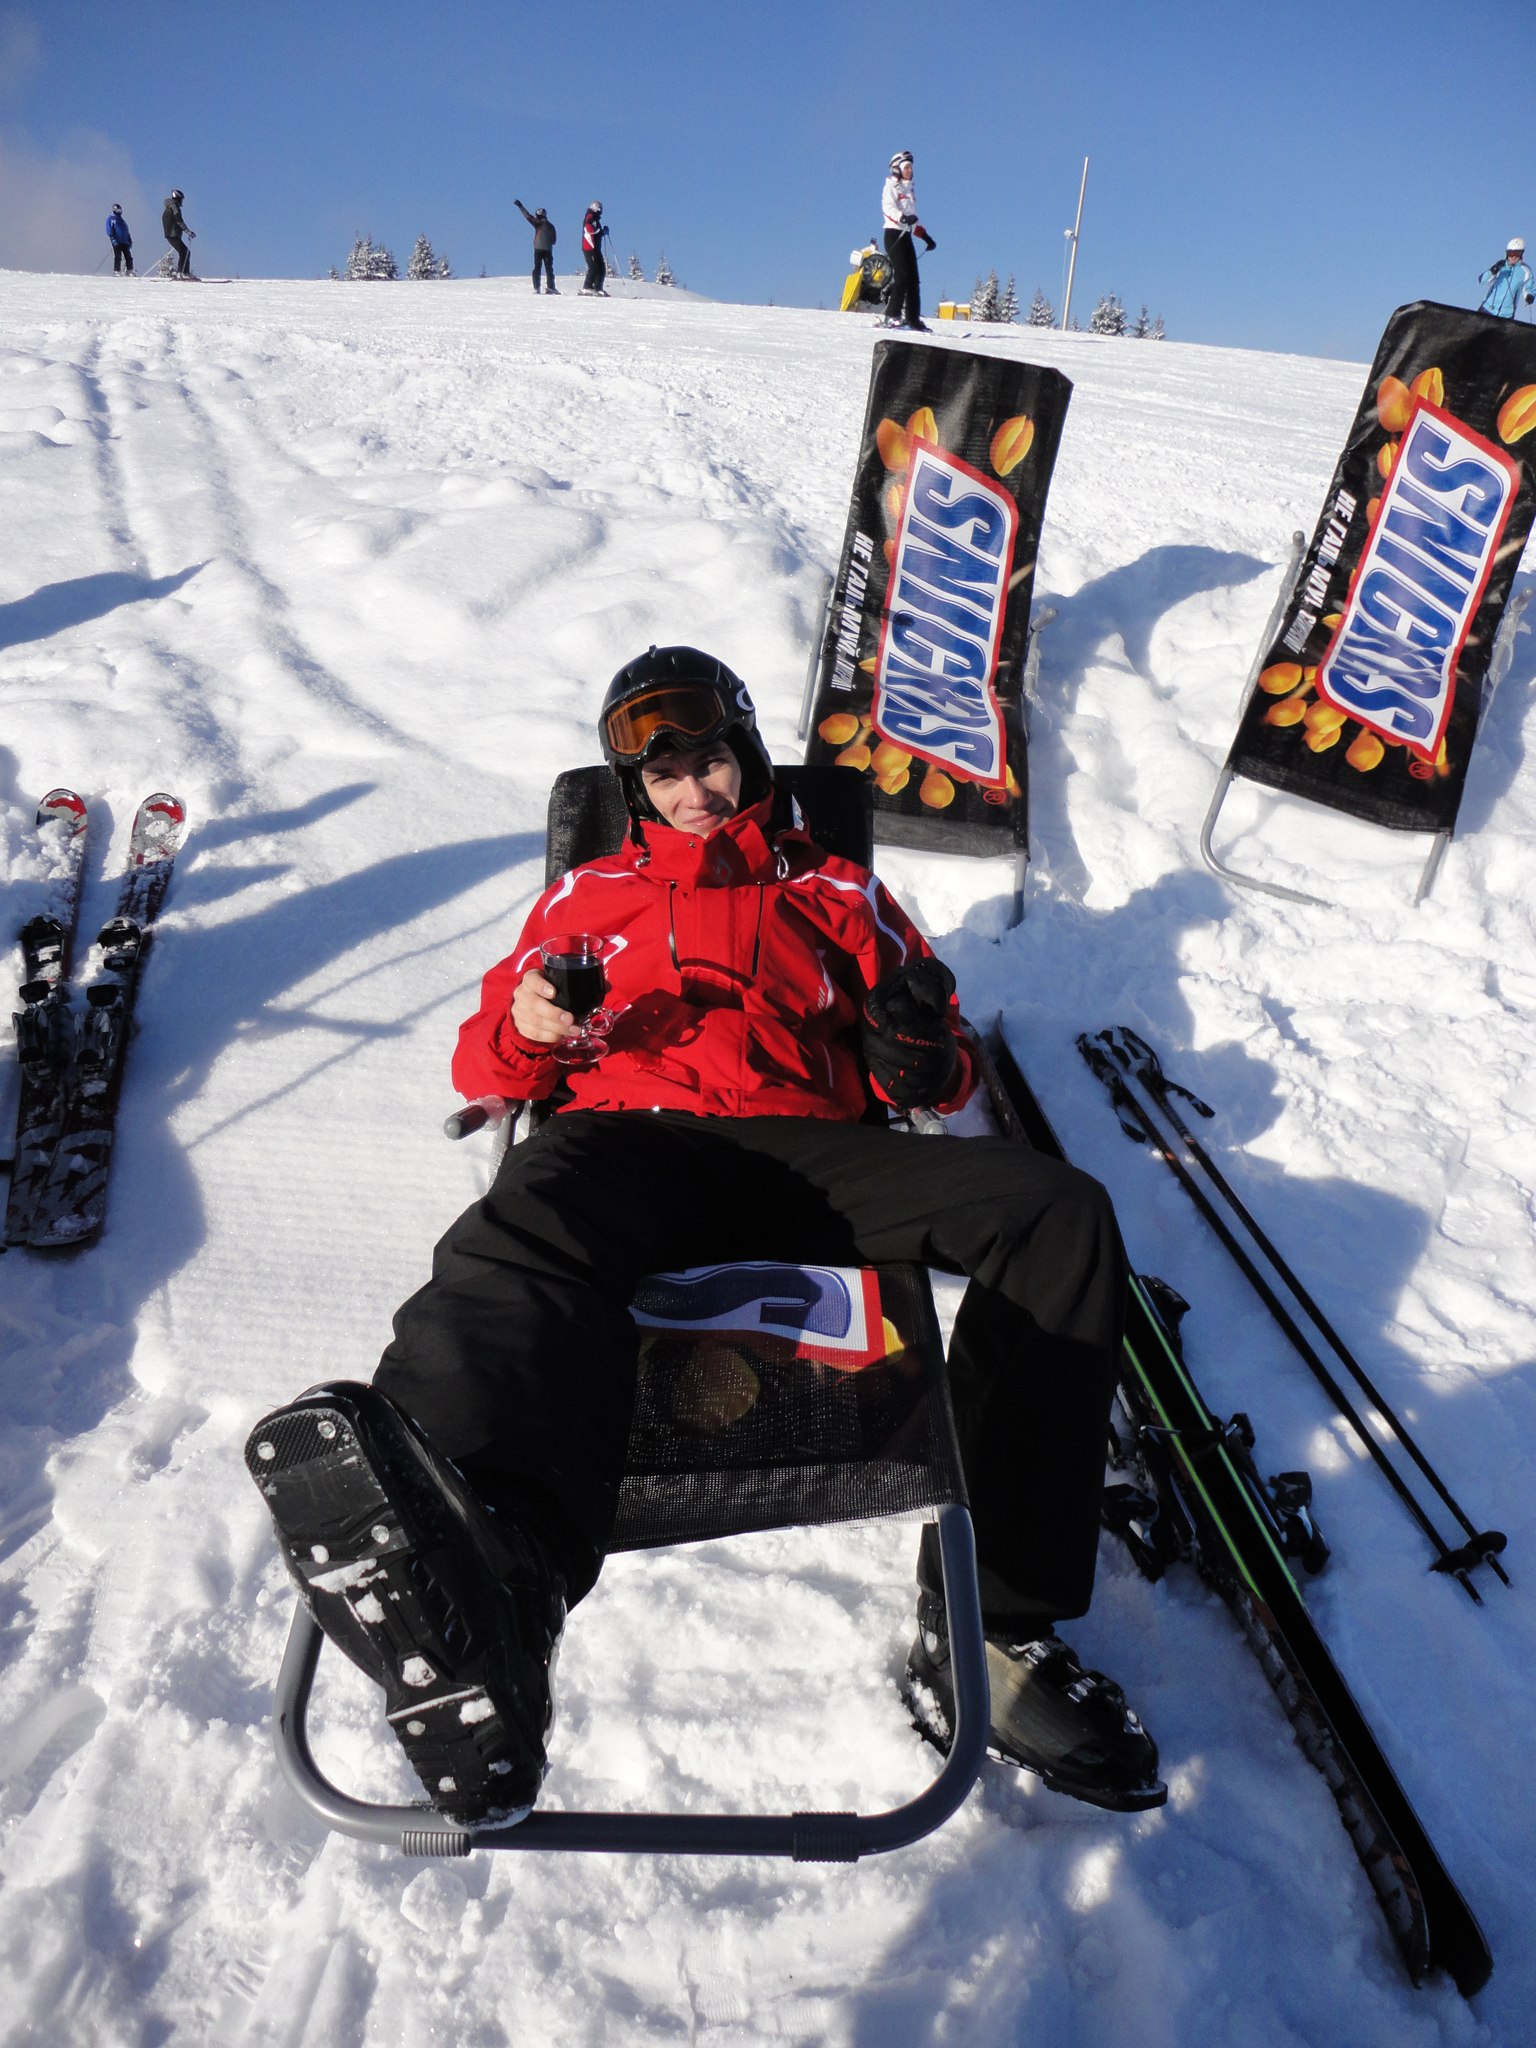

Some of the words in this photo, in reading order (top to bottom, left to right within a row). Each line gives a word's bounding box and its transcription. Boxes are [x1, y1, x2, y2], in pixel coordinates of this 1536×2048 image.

[1333, 488, 1358, 523] НЕ
[852, 530, 875, 563] НЕ
[1328, 421, 1504, 741] SNICKRS
